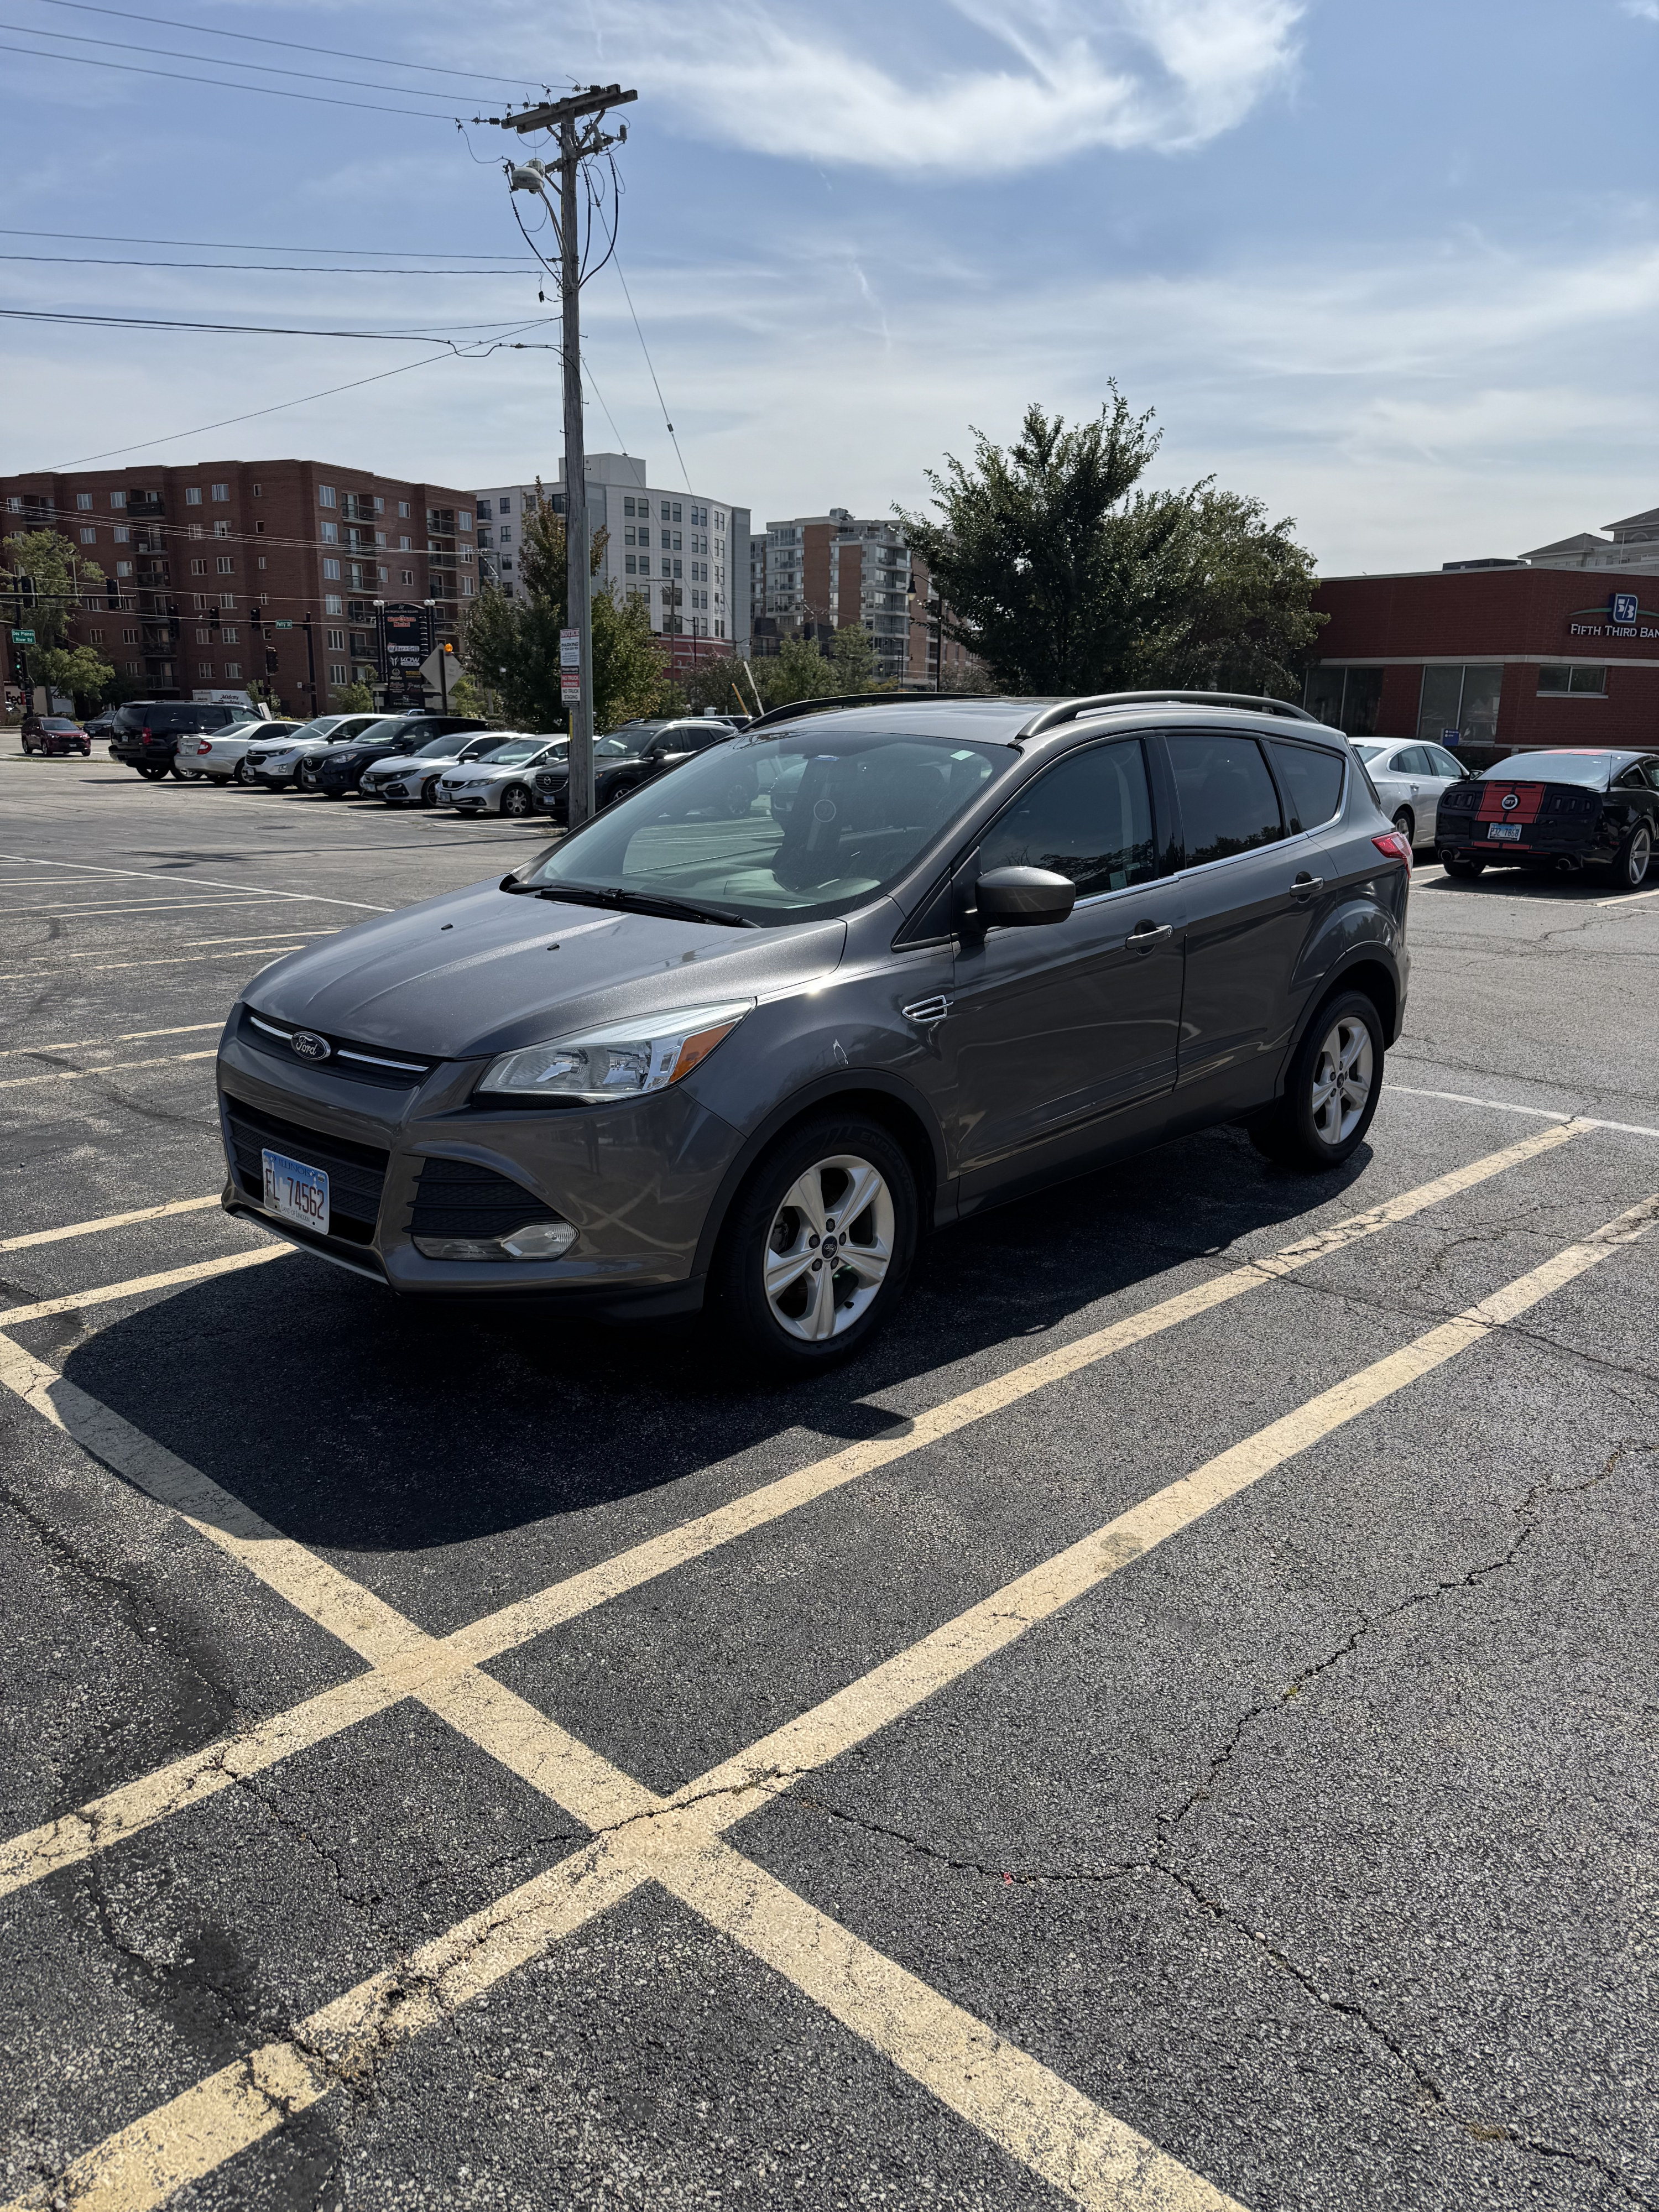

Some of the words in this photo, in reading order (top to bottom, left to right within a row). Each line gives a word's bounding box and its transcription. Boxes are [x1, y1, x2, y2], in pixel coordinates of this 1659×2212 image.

[1571, 623, 1602, 635] FIFTH
[1605, 625, 1637, 637] THIRD
[296, 1035, 318, 1056] Ford
[279, 1159, 311, 1177] ILLINOIS
[265, 1168, 280, 1202] FL
[287, 1176, 324, 1221] 74562
[281, 1204, 291, 1214] LAND
